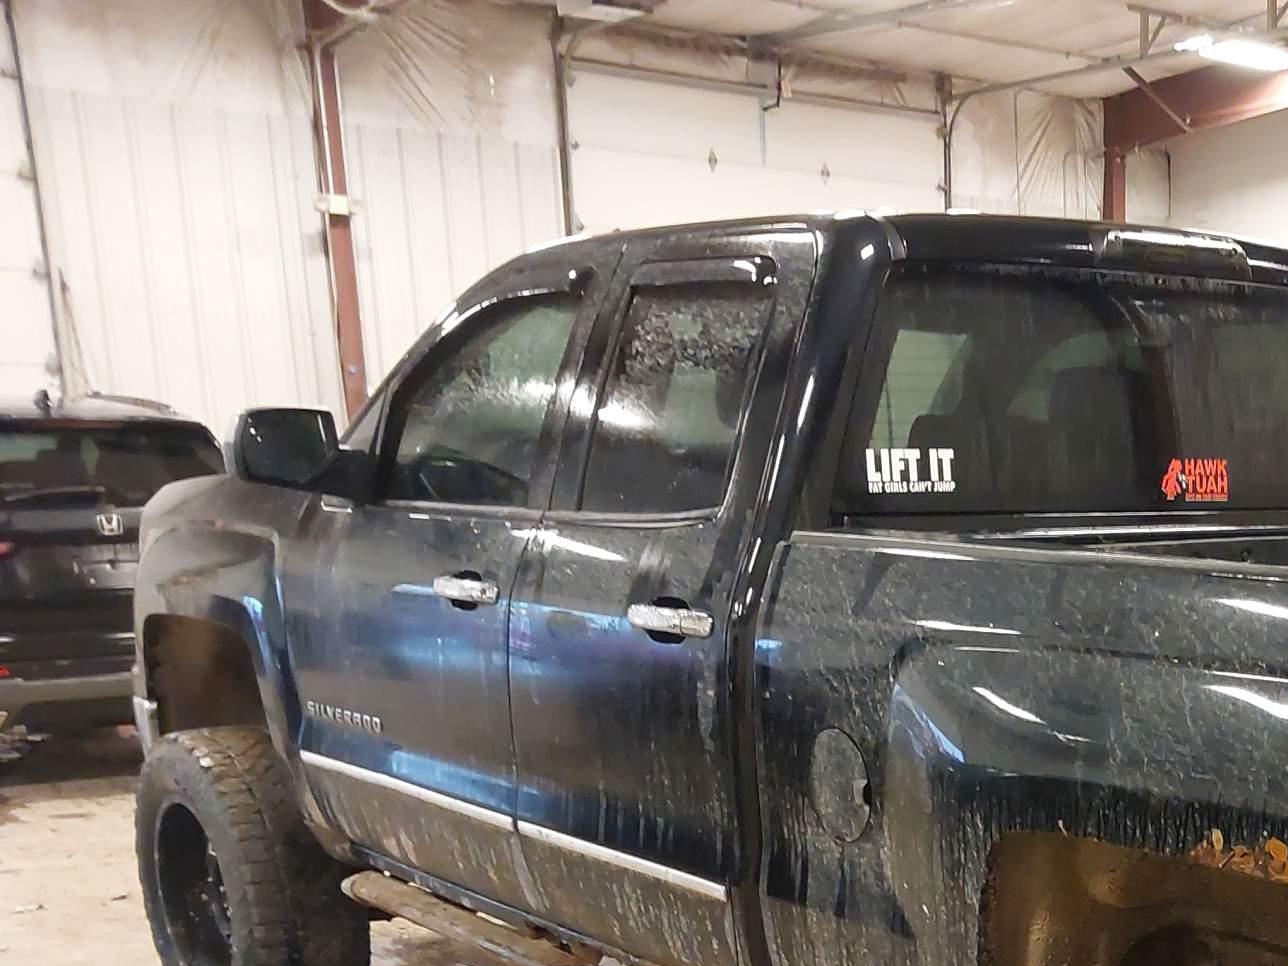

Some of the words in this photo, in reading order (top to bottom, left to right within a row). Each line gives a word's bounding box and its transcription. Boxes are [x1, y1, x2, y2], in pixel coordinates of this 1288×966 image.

[865, 447, 921, 482] LIFT
[928, 447, 955, 482] IT
[1184, 457, 1228, 476] HAWK
[868, 480, 883, 494] FAT
[884, 480, 908, 493] GIRLS
[909, 480, 932, 493] CAN'T
[933, 480, 956, 493] JUMP
[1185, 474, 1229, 494] TUAH
[306, 700, 383, 735] SILVERADO
